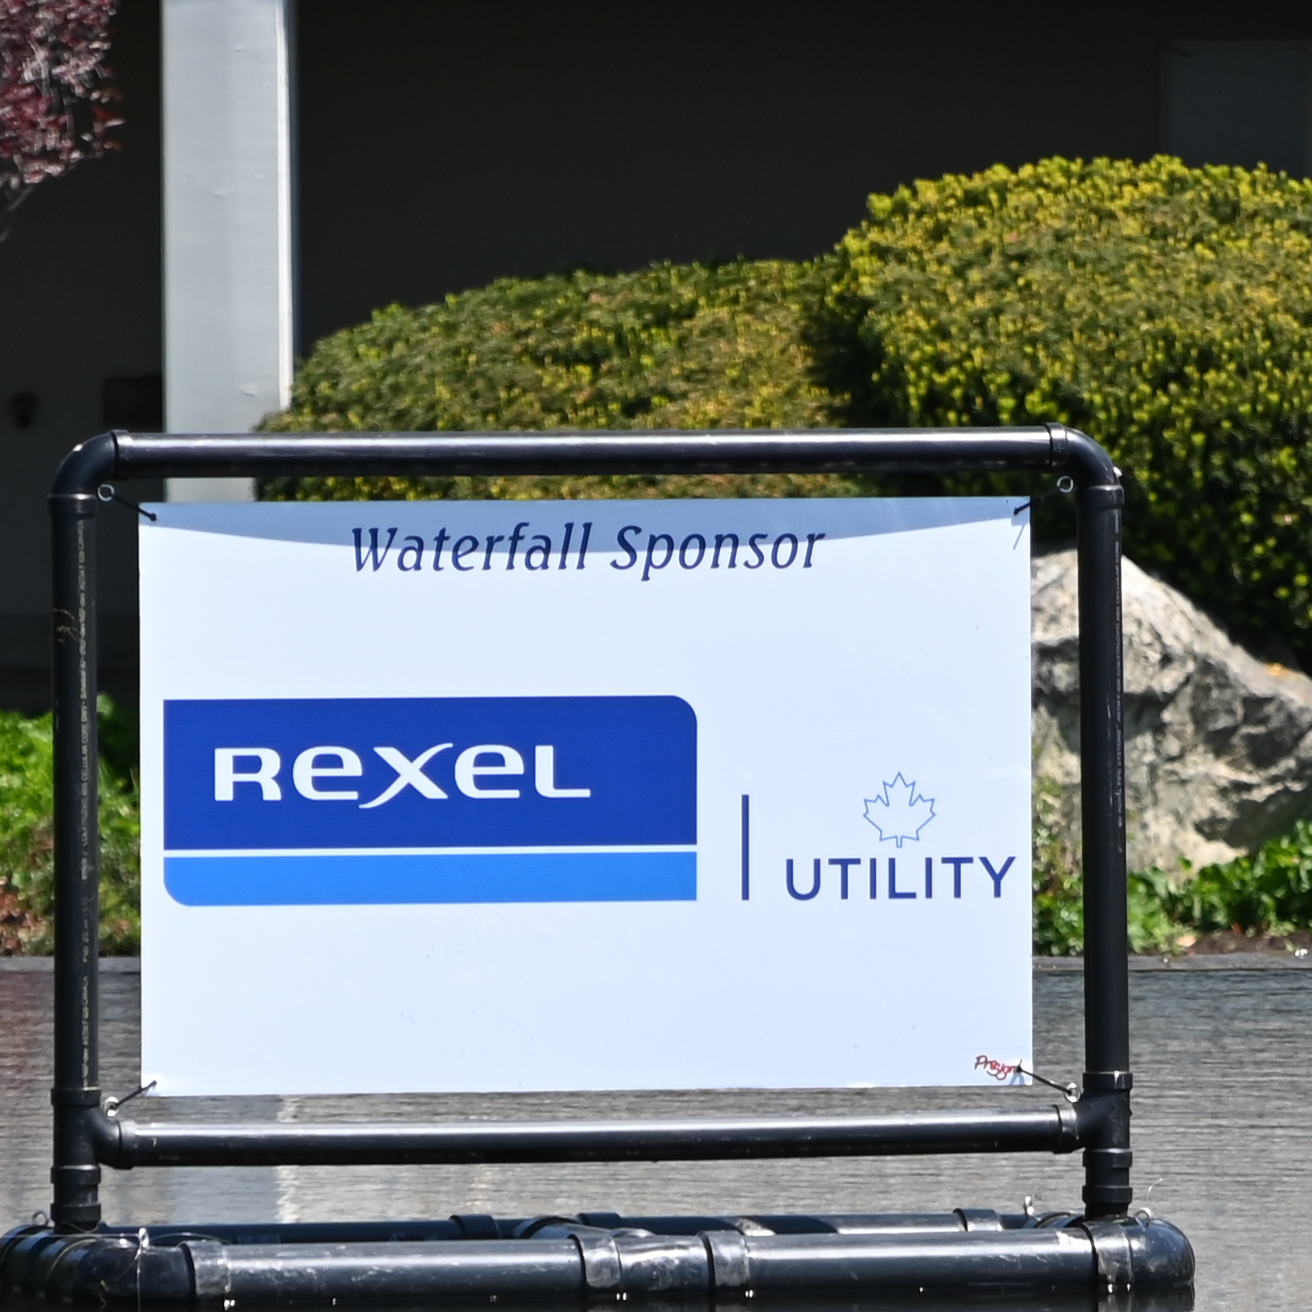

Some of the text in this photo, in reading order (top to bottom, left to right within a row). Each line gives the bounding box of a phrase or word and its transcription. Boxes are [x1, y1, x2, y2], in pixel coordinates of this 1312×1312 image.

[351, 521, 827, 582] Waterfall Sponsor
[785, 856, 1017, 901] UTILITY
